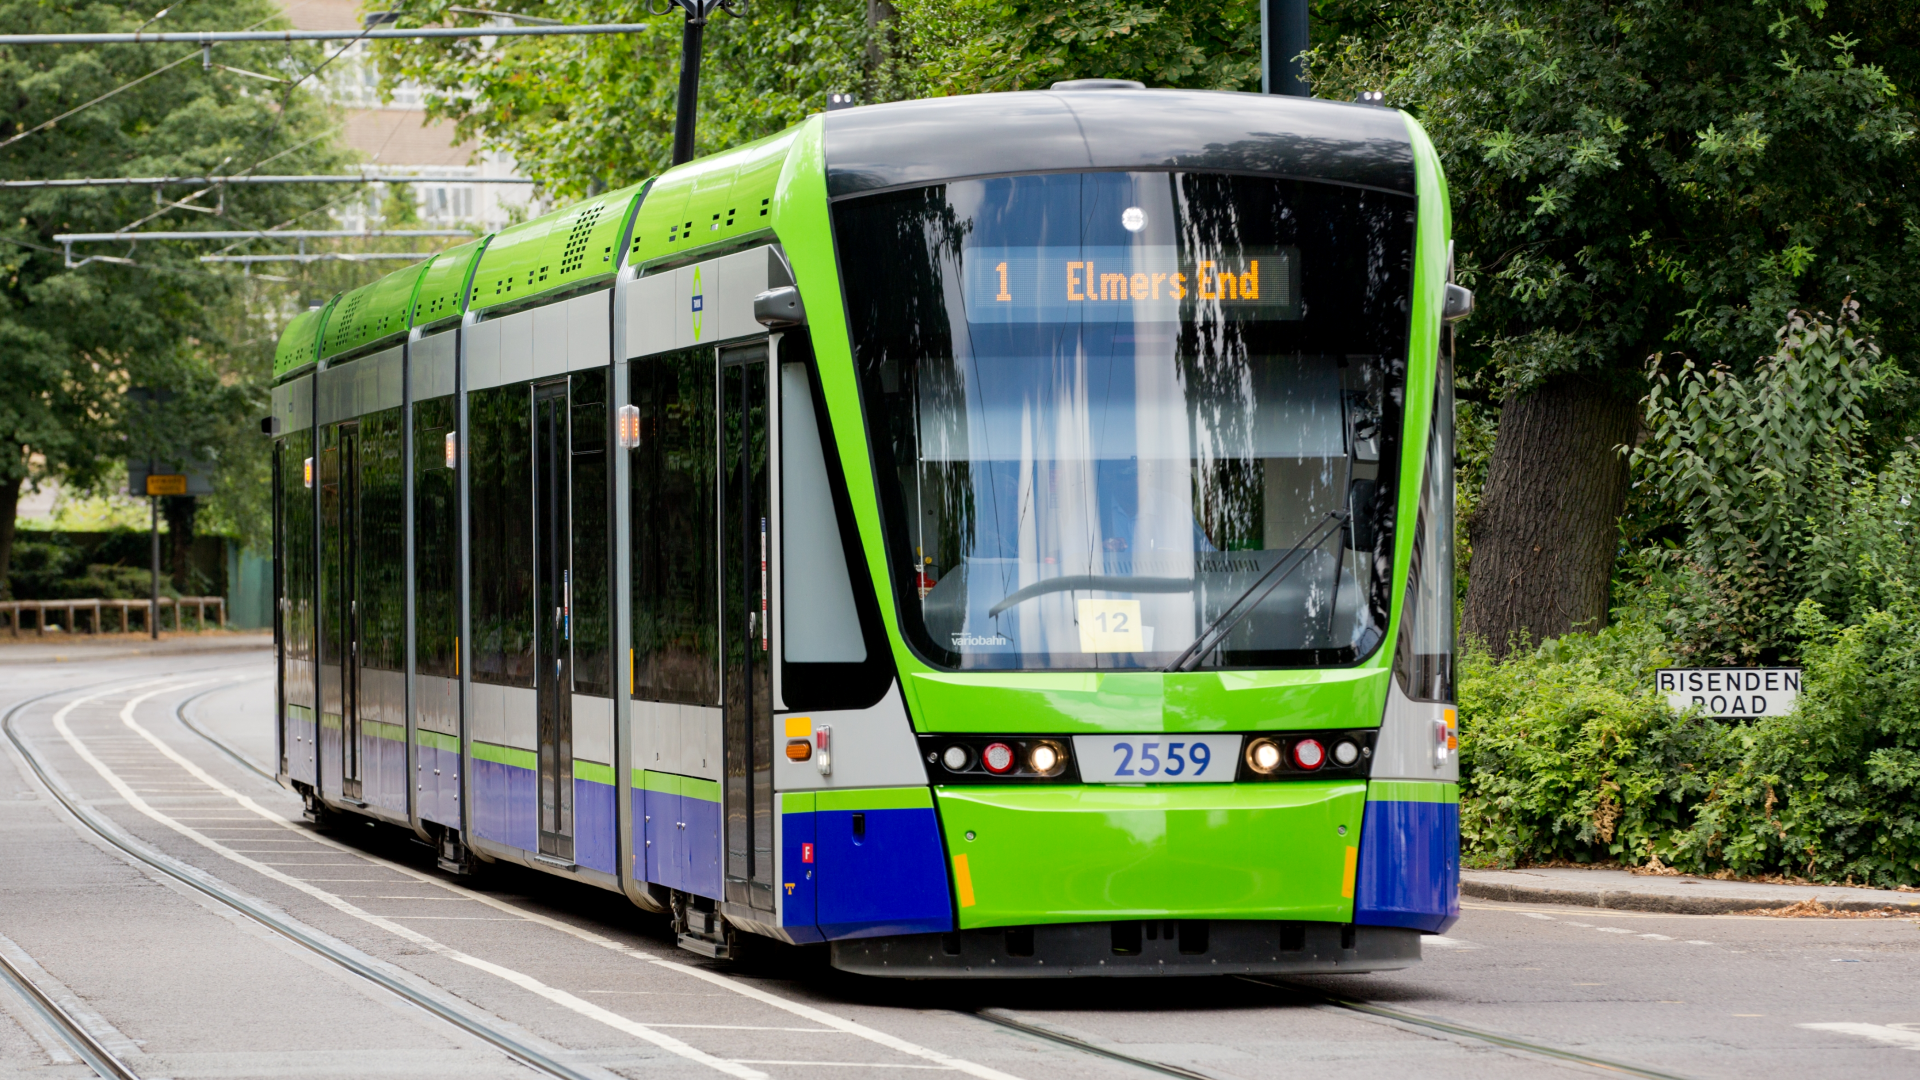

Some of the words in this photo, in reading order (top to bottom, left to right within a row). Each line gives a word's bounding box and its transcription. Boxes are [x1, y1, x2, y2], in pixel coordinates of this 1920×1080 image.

[996, 262, 1011, 301] 1
[1067, 261, 1187, 301] Elmers
[1198, 260, 1259, 300] End
[1095, 611, 1129, 633] 12
[951, 635, 1006, 646] variobahn
[1660, 672, 1799, 692] BISENDEN
[1113, 742, 1211, 776] 2559
[805, 846, 811, 860] F
